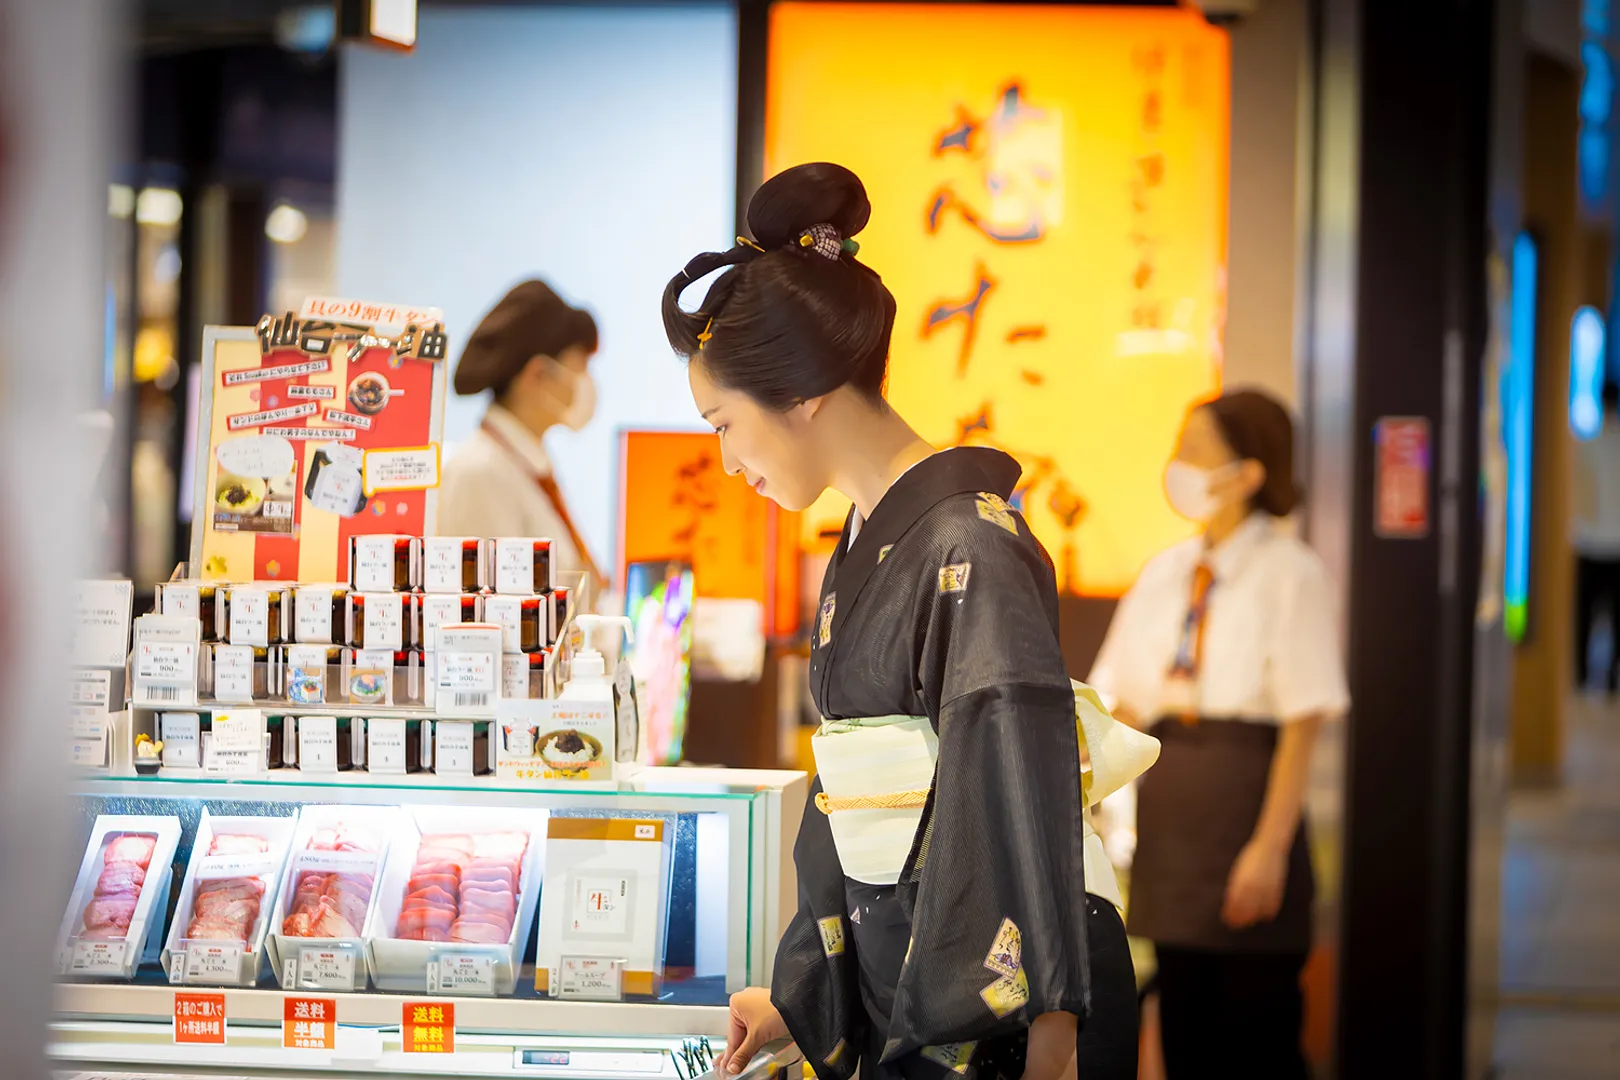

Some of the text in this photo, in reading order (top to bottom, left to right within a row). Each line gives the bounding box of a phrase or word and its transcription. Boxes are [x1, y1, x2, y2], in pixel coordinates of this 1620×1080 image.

[176, 1000, 223, 1017] 2箱のご購入で
[294, 1001, 326, 1019] 送料
[413, 1006, 445, 1023] 送料
[293, 1020, 326, 1039] 半額
[413, 1025, 445, 1043] 無料
